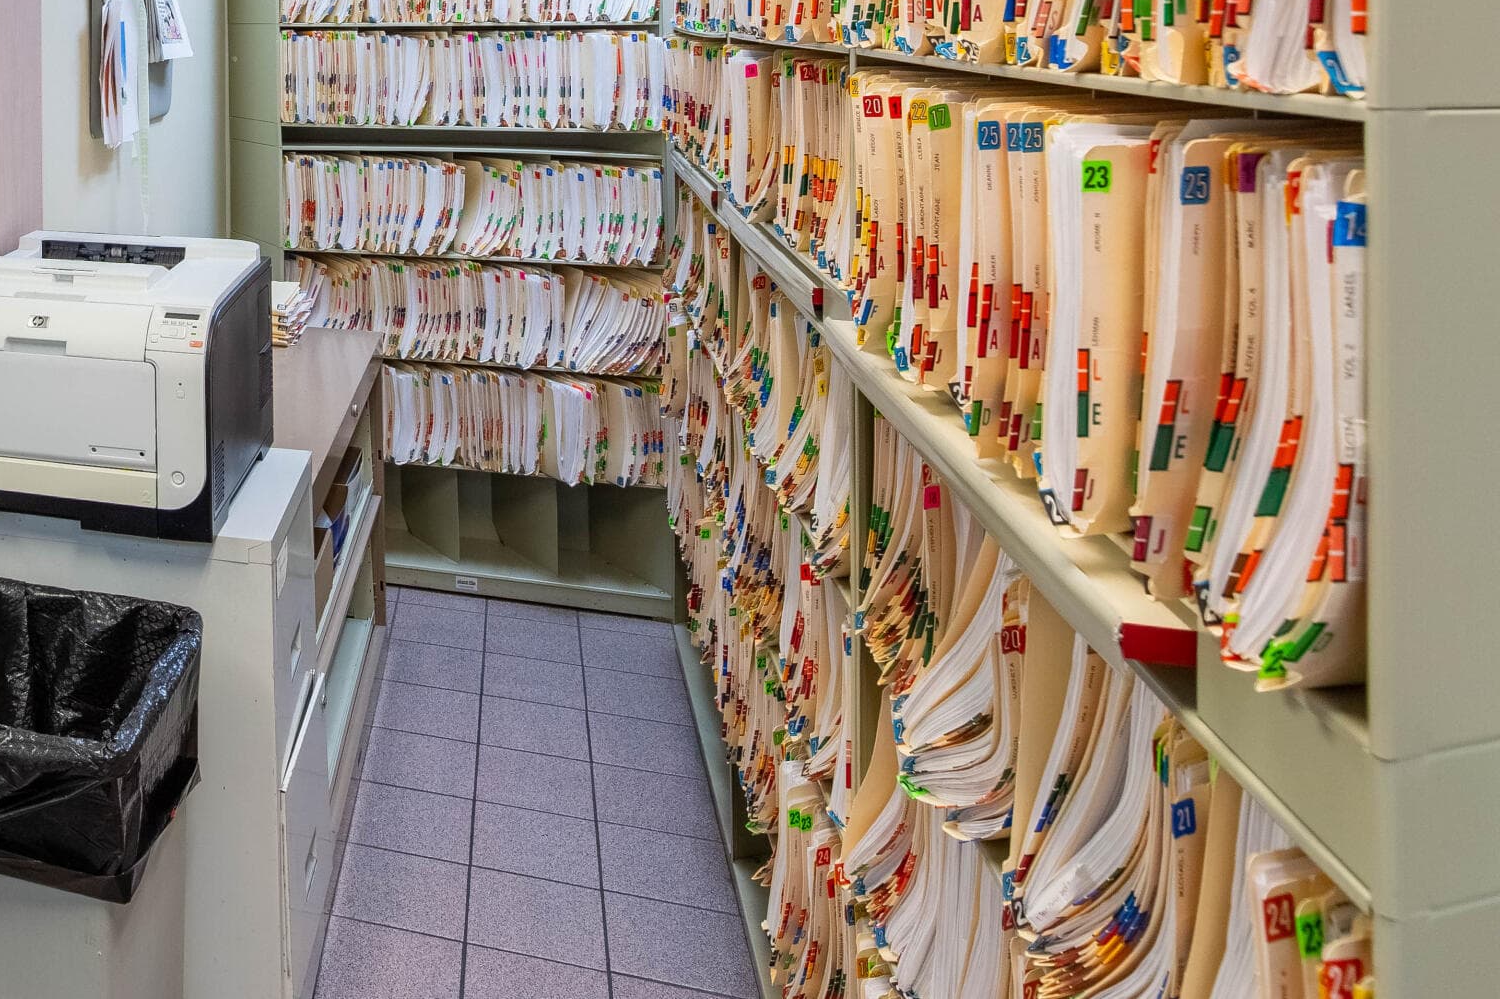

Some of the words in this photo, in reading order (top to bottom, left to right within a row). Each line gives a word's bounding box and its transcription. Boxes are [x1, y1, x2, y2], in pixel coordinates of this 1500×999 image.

[973, 4, 983, 22] A
[863, 98, 881, 115] 20
[912, 103, 928, 121] 22
[981, 126, 999, 145] 25
[1024, 128, 1043, 148] 25
[1083, 166, 1109, 189] 23
[1184, 173, 1209, 200] 25
[1093, 404, 1101, 425] E
[1175, 436, 1187, 459] E
[1002, 631, 1021, 651] 20
[1176, 809, 1191, 831] 21
[1267, 899, 1291, 935] 24
